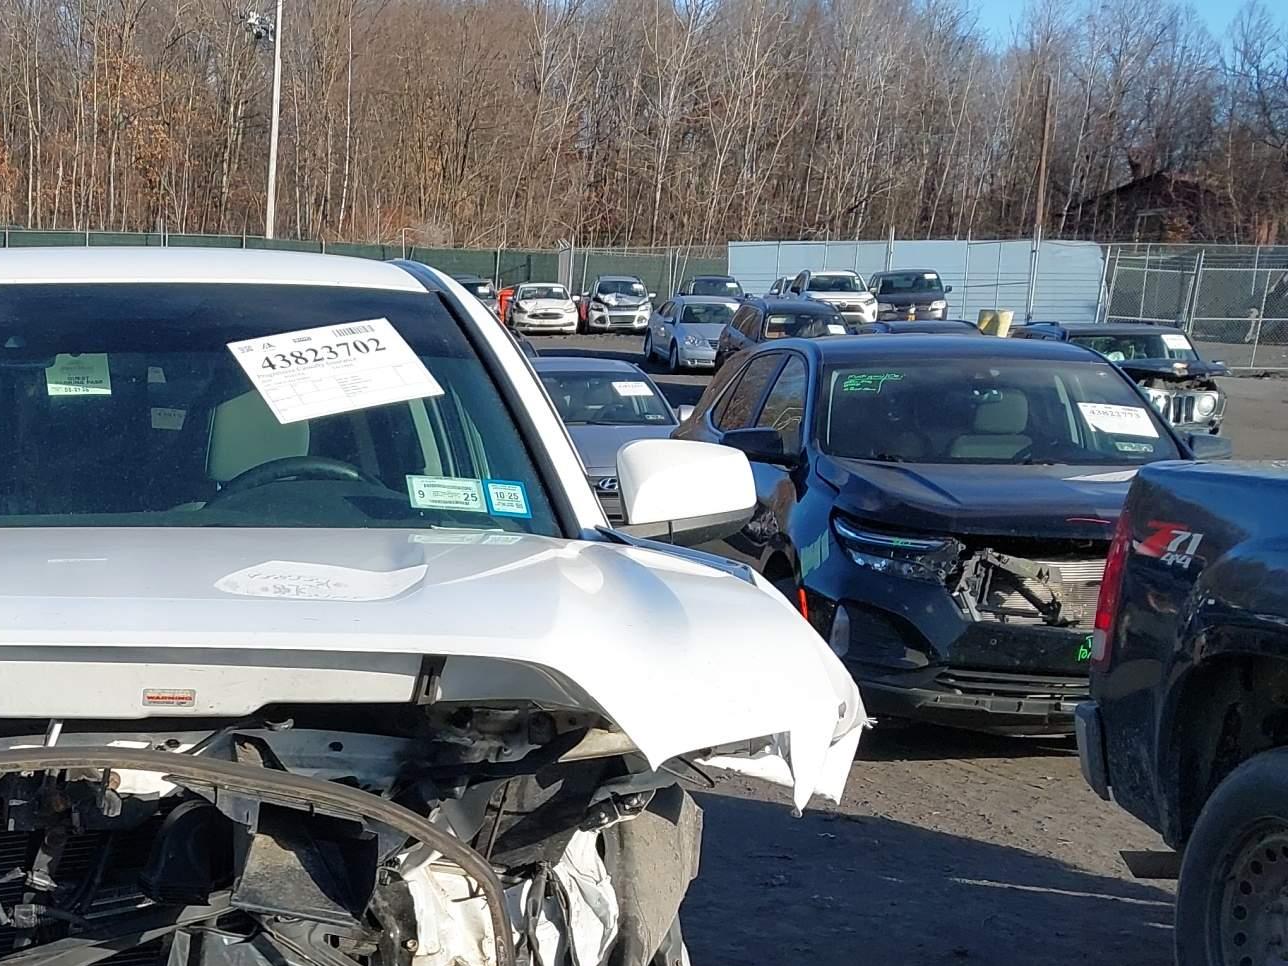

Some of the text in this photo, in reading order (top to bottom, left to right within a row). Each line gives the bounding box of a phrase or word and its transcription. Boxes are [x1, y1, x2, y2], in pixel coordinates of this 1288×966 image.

[261, 337, 387, 370] 43823702
[418, 490, 425, 498] 9
[463, 492, 478, 502] 25
[495, 491, 519, 500] 10 25
[1134, 519, 1204, 558] Z71
